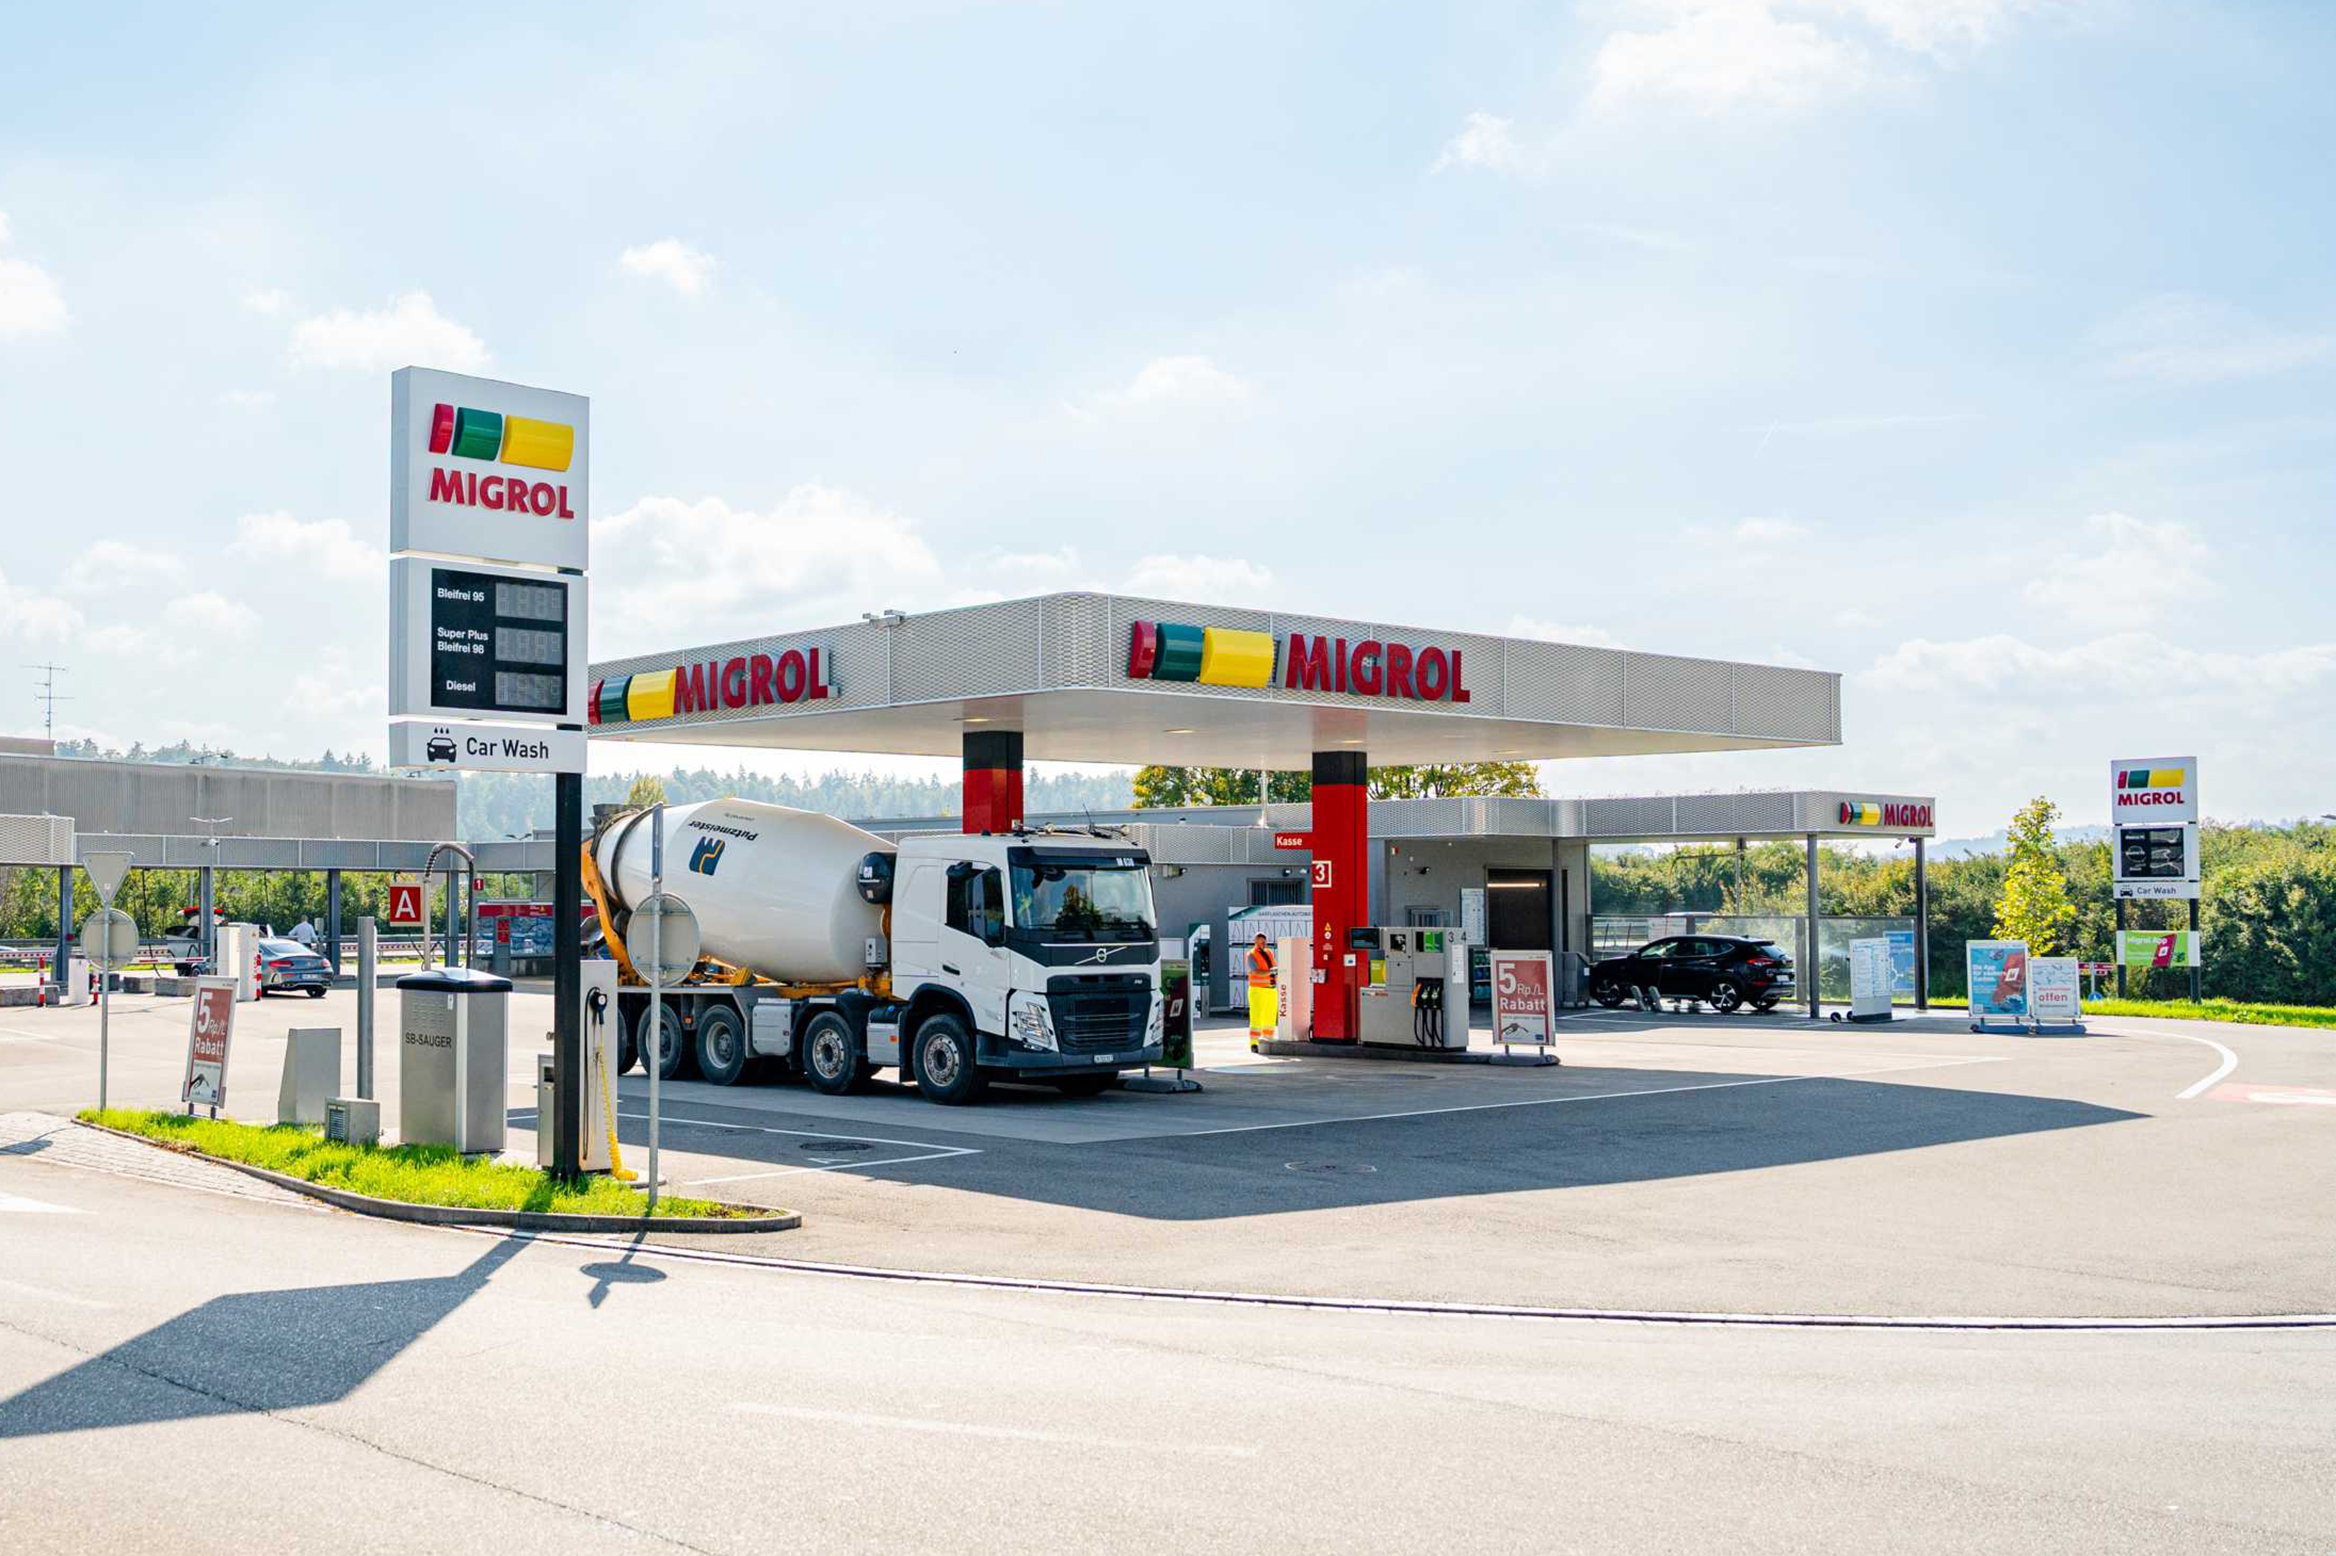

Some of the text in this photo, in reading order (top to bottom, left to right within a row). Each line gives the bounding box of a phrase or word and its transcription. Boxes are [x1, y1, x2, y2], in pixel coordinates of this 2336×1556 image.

[430, 467, 574, 519] MIGROL
[437, 588, 485, 601] Bleifrei 95
[437, 627, 489, 641] Super Plus
[437, 641, 485, 654] Bleifrei 98
[1286, 632, 1471, 703] MIGROL
[446, 680, 476, 692] Diesel
[673, 646, 829, 714] MIGROL
[466, 737, 549, 759] Car Wash
[2118, 792, 2184, 806] MIGROL
[1883, 804, 1933, 827] MIGROL
[688, 820, 759, 841] Putzmeister
[1276, 836, 1303, 847] Kasse
[1315, 863, 1325, 882] 3
[476, 879, 482, 890] 1
[2137, 886, 2176, 895] Car Wash
[395, 889, 416, 918] A
[1448, 931, 1455, 943] 3
[1460, 931, 1467, 941] 4
[1498, 963, 1545, 997] 5 Rp./L
[1279, 984, 1287, 1017] Kasse
[1500, 998, 1546, 1011] Rabatt
[2038, 992, 2068, 1002] offen
[197, 991, 213, 1034] 5
[193, 1037, 225, 1055] Rabatt
[405, 1032, 452, 1049] SB-SAUGER
